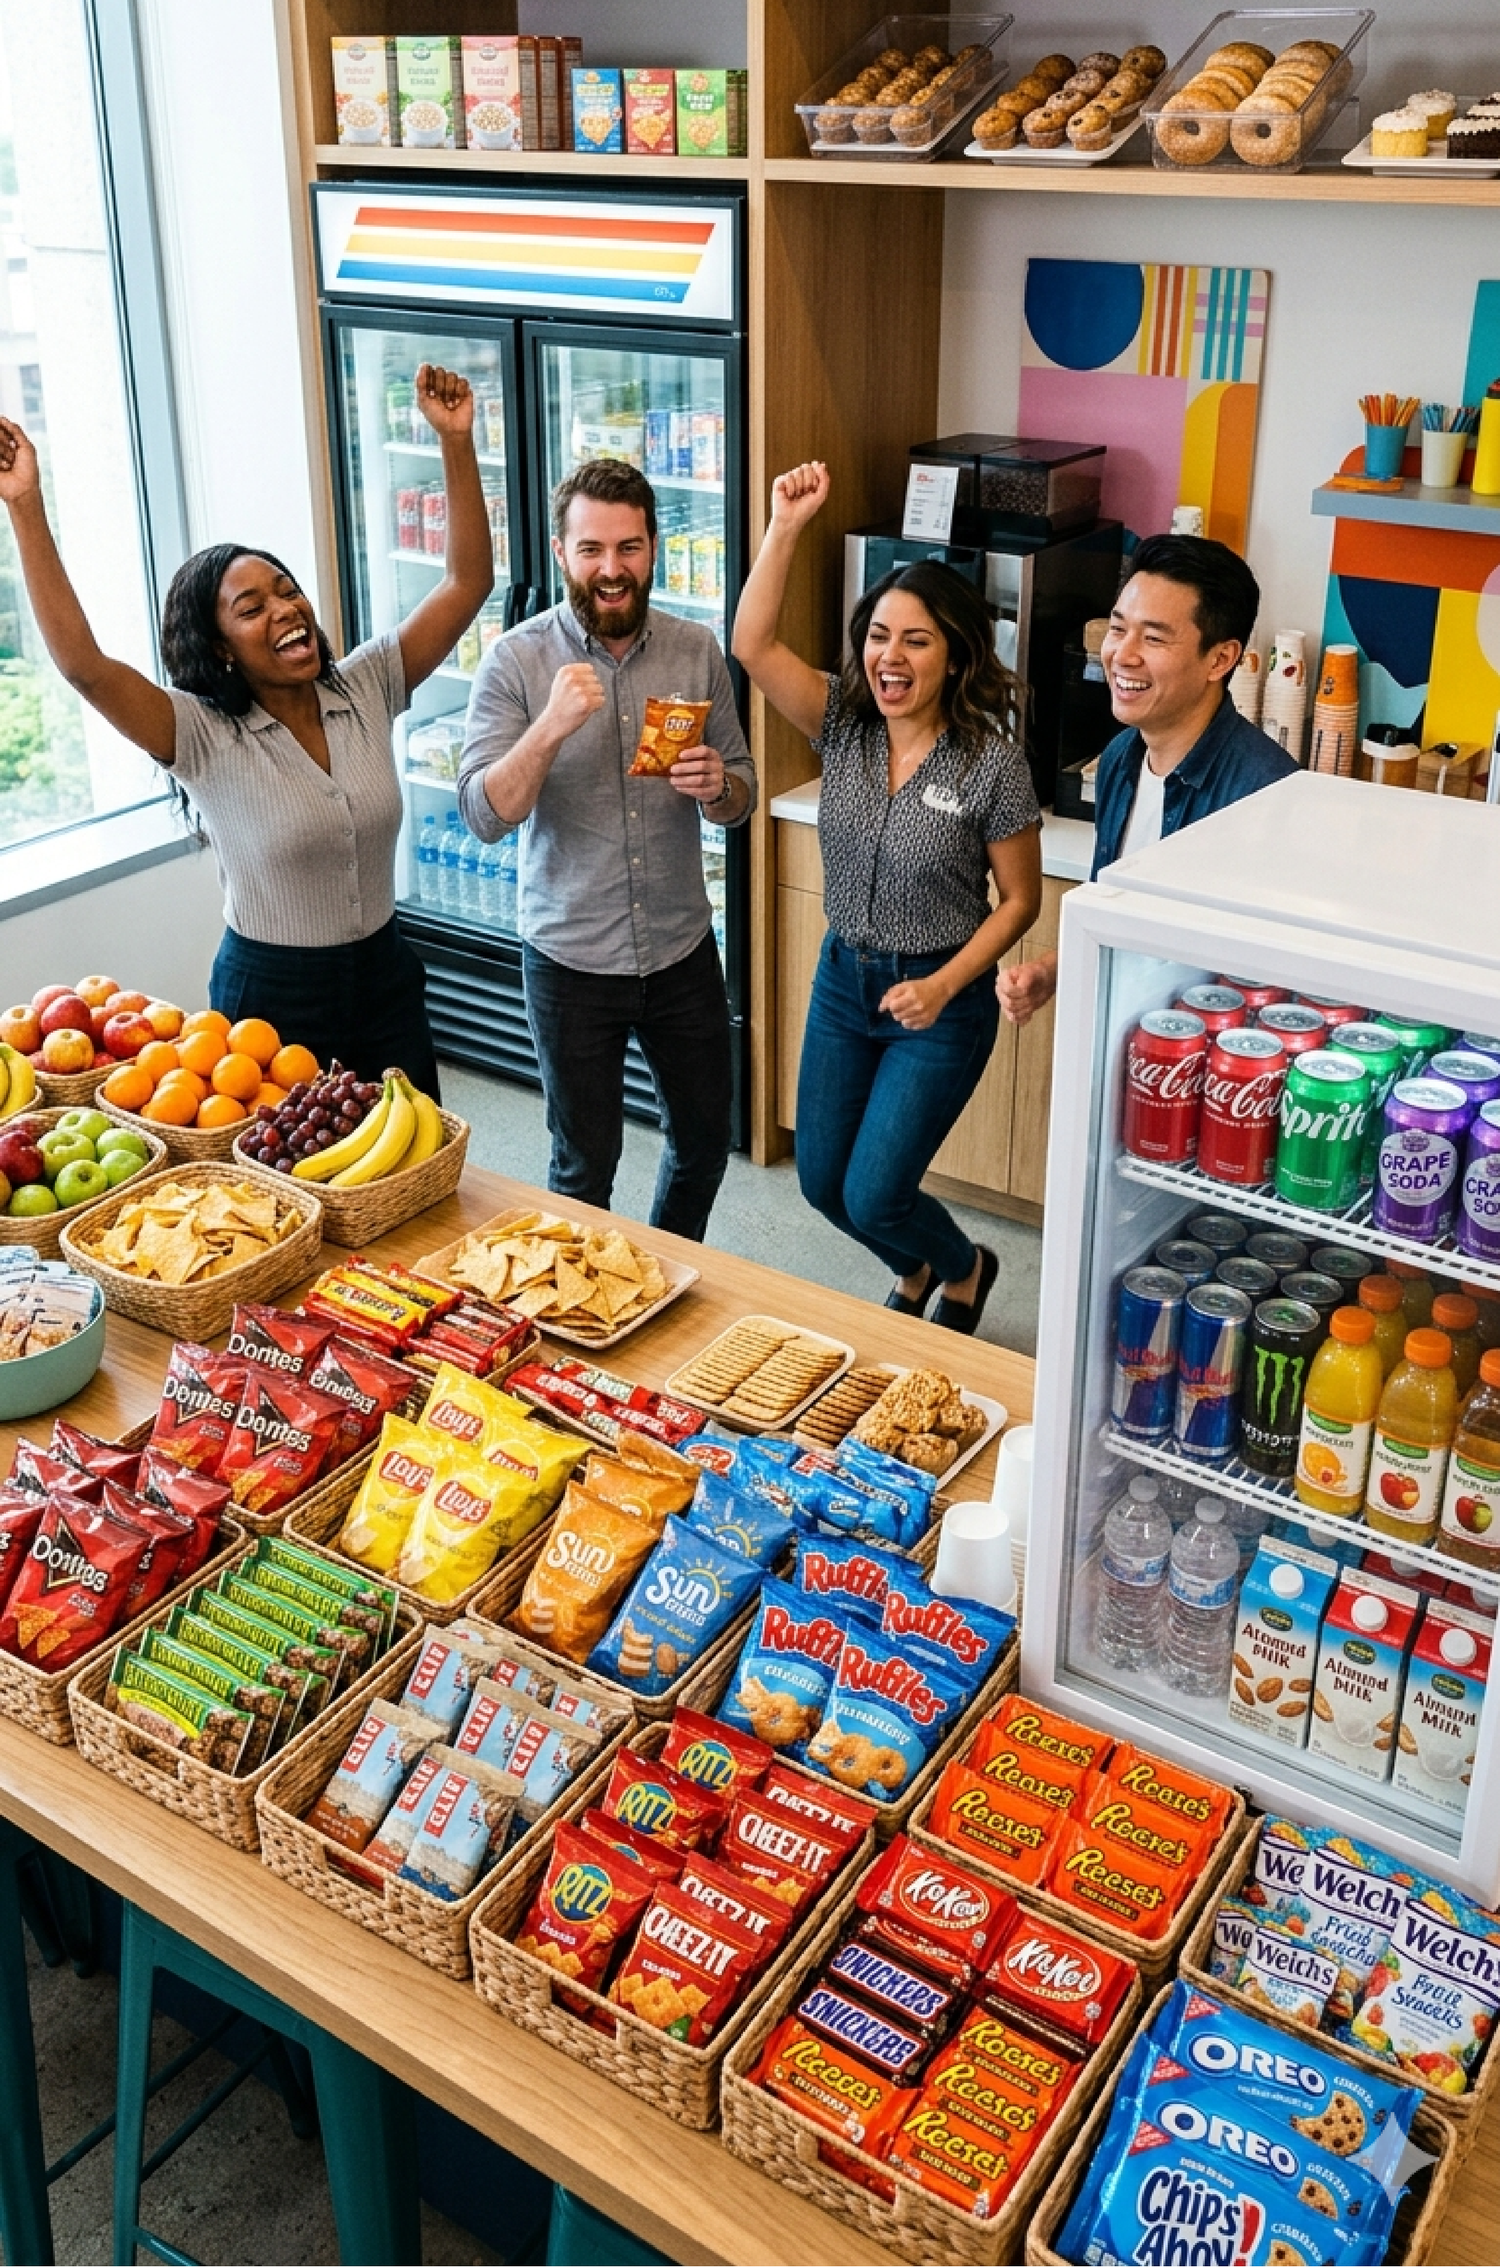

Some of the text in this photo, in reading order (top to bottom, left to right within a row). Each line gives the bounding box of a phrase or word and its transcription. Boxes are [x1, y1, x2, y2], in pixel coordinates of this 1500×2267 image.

[1382, 1151, 1451, 1173] GRAPE
[1388, 1172, 1442, 1190] SODA
[1474, 1198, 1500, 1216] SO
[882, 1591, 989, 1665] Ruffles
[838, 1644, 948, 1726] Ruffles
[1314, 1863, 1402, 1919] Welch
[1192, 2036, 1325, 2096] OREO
[1160, 2102, 1297, 2176] OREO
[1140, 2170, 1241, 2238] Chips
